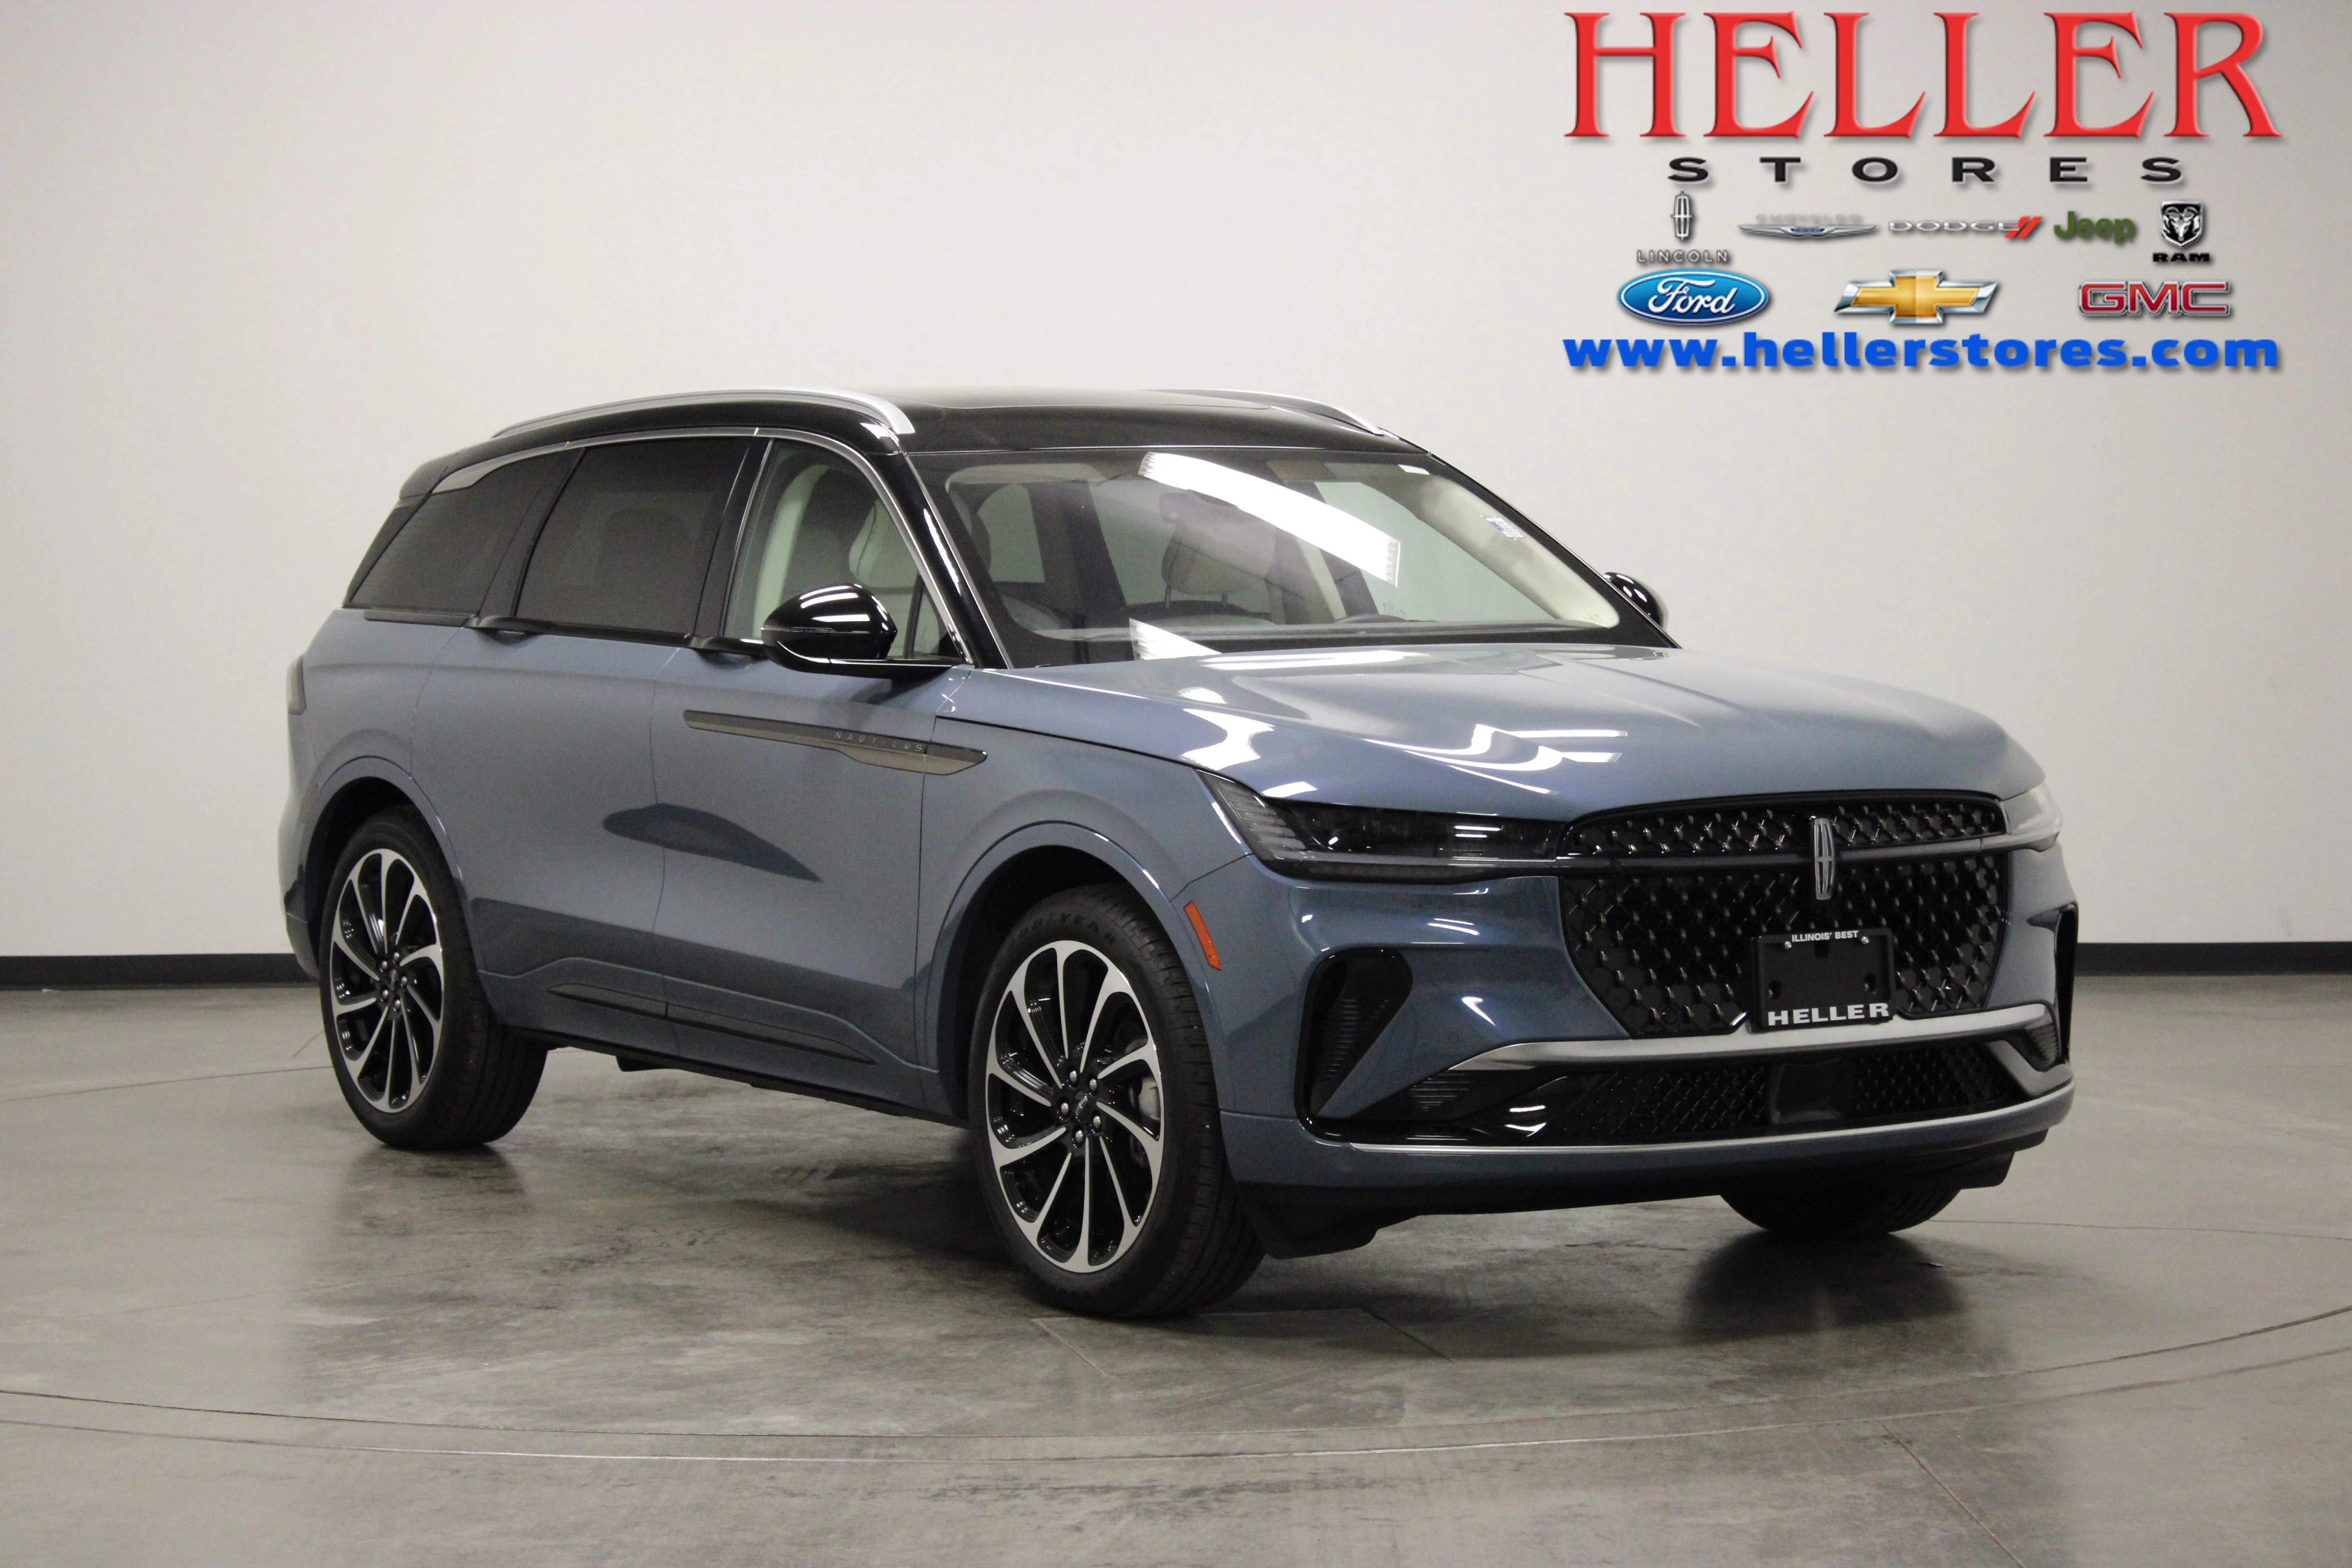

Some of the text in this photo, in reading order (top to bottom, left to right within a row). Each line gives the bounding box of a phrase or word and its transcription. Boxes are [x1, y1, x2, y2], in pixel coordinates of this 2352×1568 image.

[835, 731, 922, 752] NAUTILUS
[1835, 930, 1859, 939] BEST
[1768, 1003, 1890, 1026] HELLER
